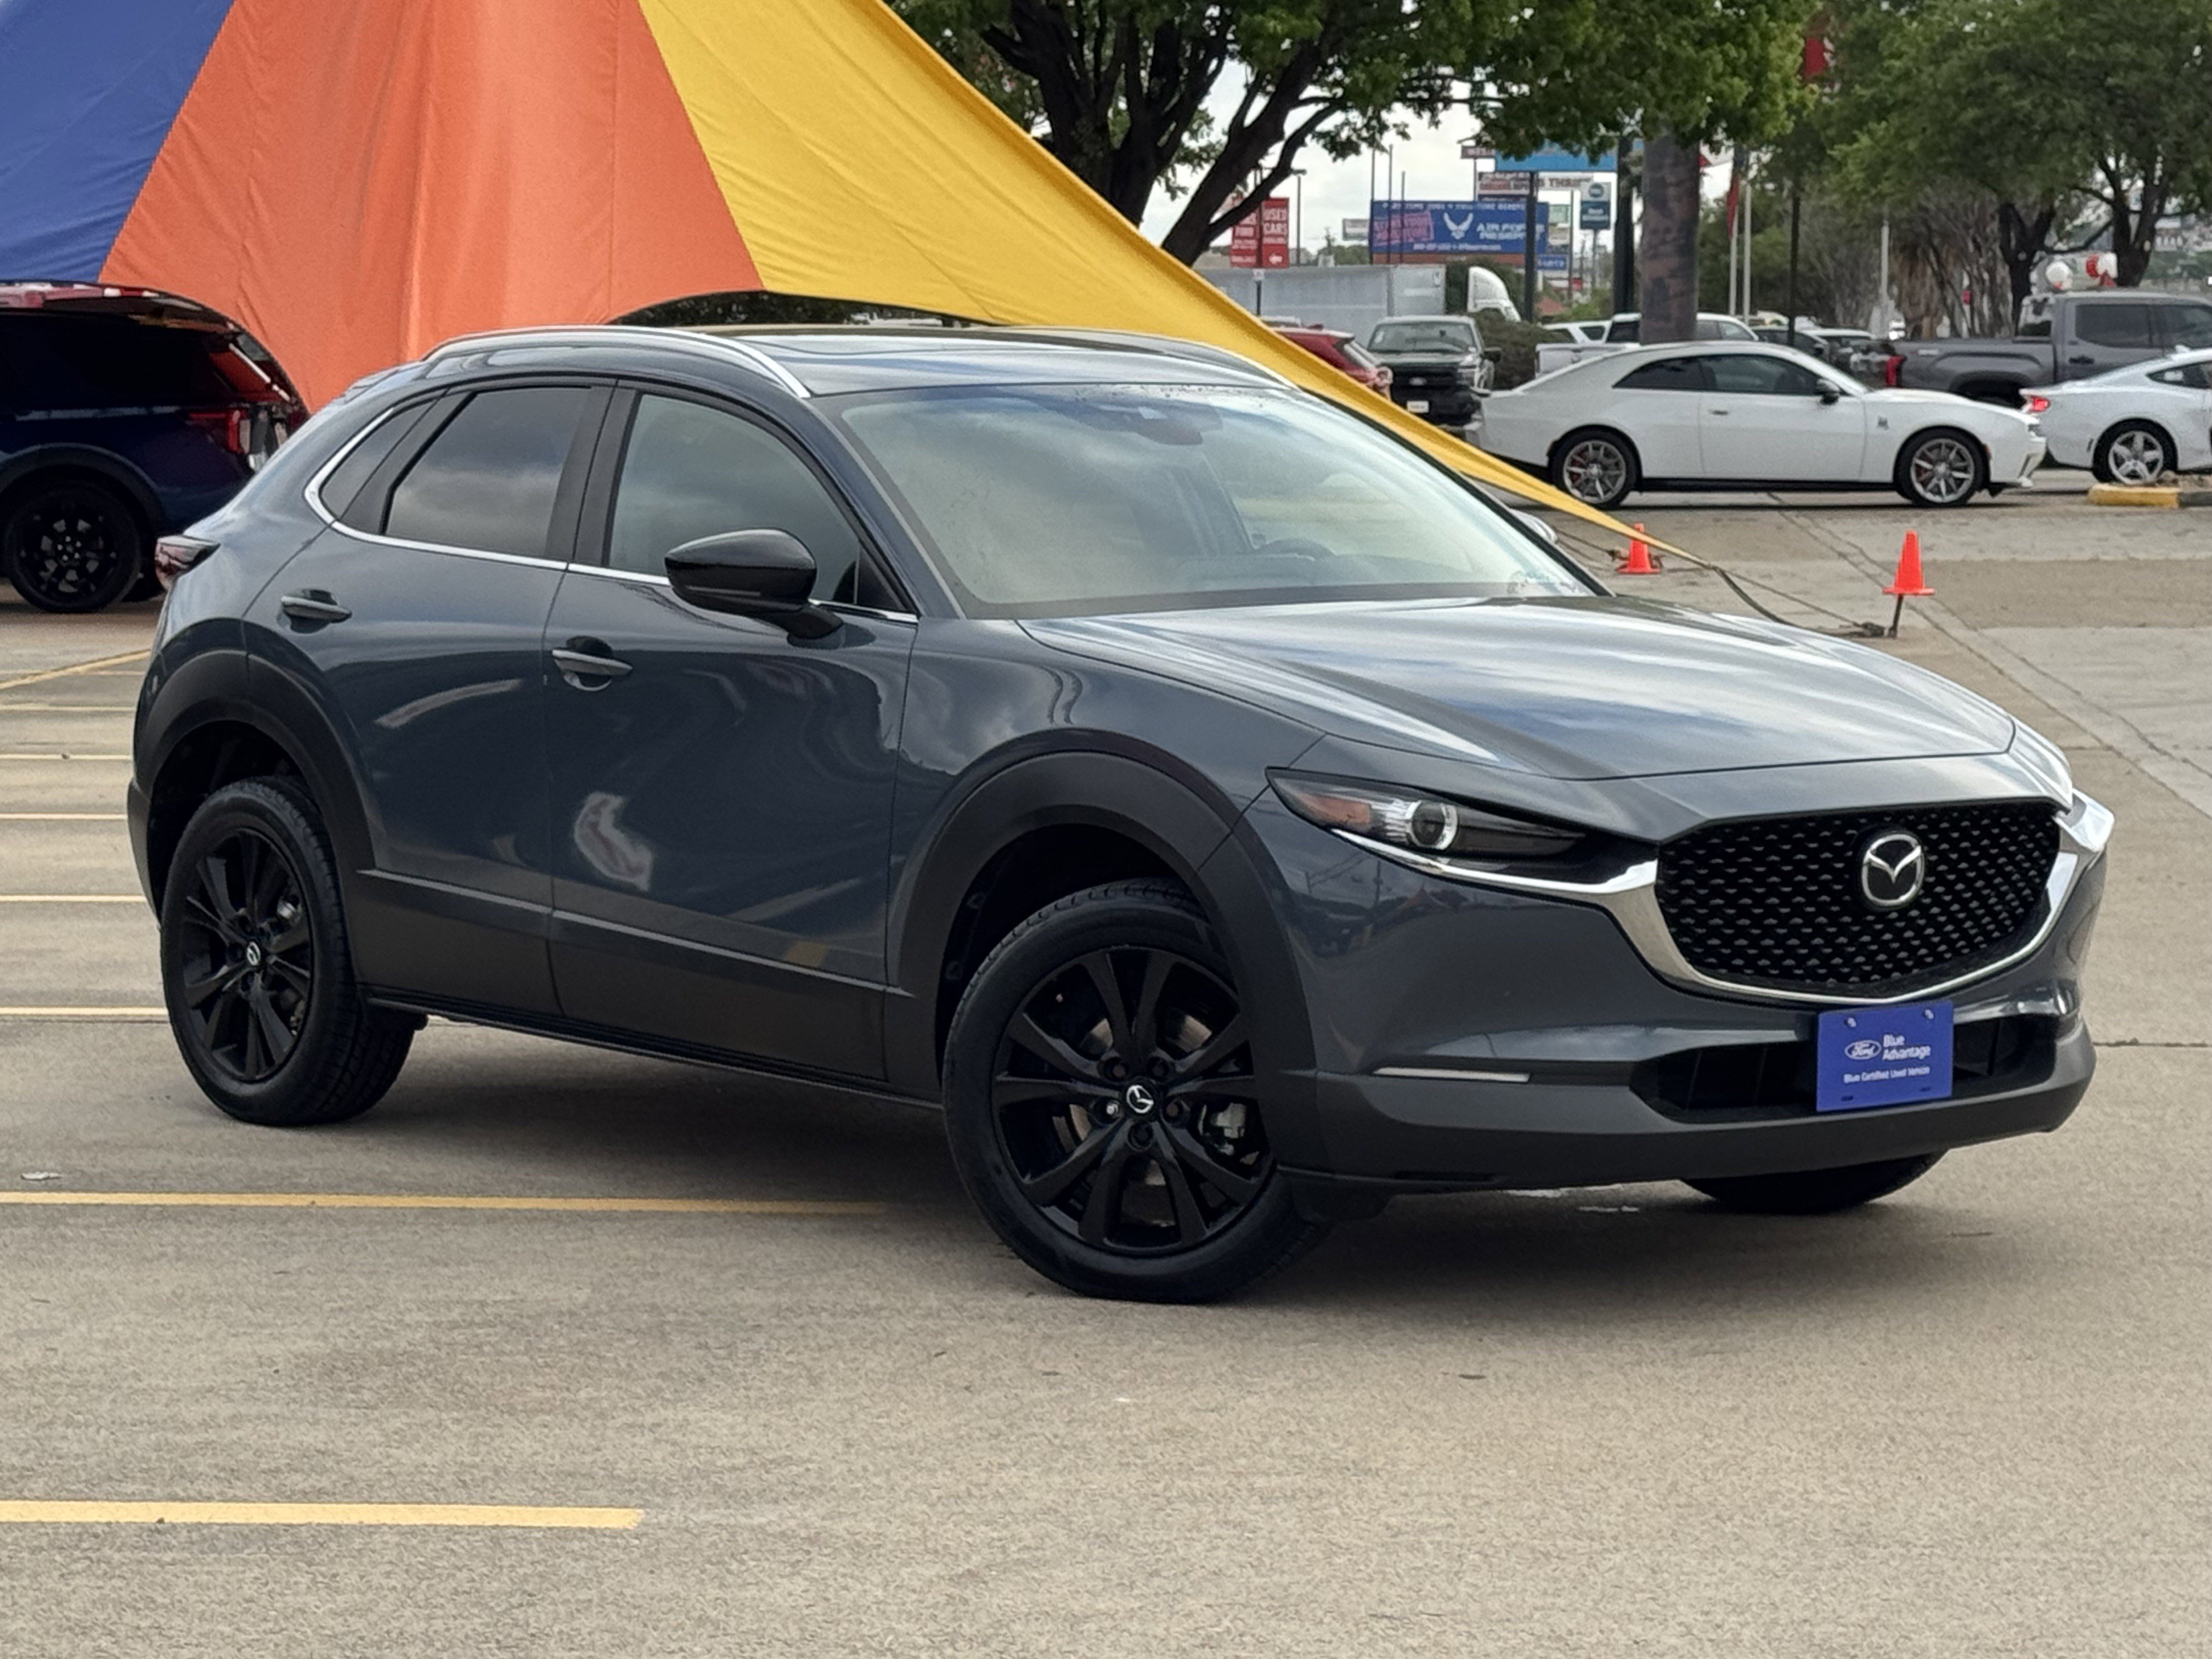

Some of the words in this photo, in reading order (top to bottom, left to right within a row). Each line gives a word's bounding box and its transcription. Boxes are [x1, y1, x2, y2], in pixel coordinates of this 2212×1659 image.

[1883, 1034, 1905, 1047] Blue
[1882, 1045, 1931, 1060] Advantage
[1843, 1074, 1860, 1084] Blue
